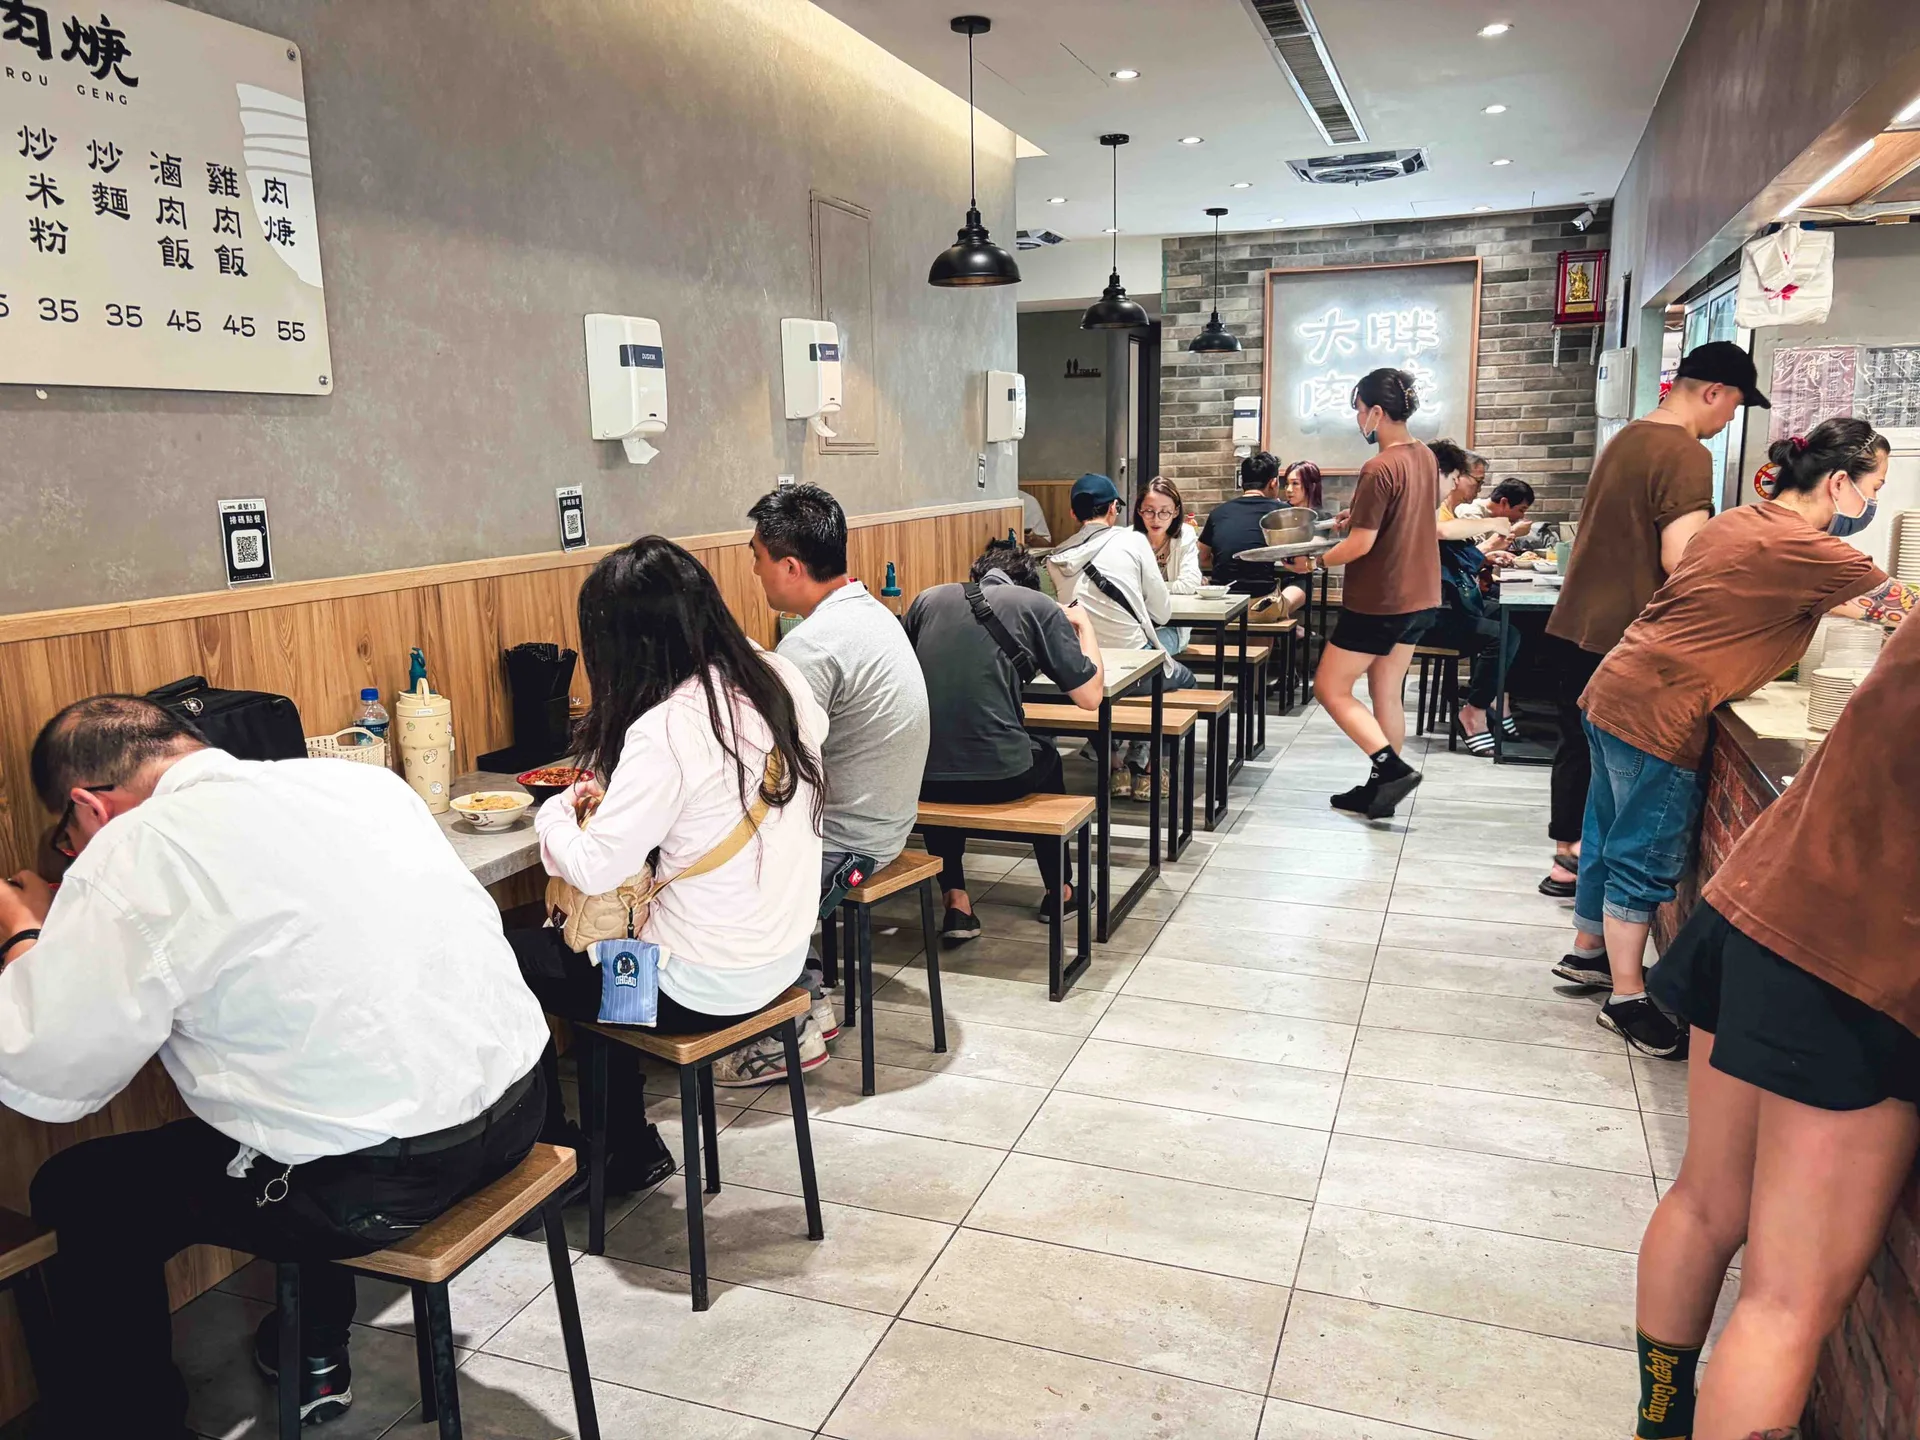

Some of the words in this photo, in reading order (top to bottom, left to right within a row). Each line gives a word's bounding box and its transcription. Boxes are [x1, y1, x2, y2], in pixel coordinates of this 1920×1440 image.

[5, 66, 49, 87] ROU
[76, 84, 128, 106] GENG
[17, 125, 69, 255] 炒米粉
[86, 139, 131, 221] 炒麵
[150, 151, 195, 271] 滷肉飯
[205, 162, 249, 278] 雞肉飯
[38, 297, 79, 323] 35
[105, 303, 143, 328] 35
[166, 309, 202, 333] 45
[222, 314, 256, 338] 45
[277, 320, 306, 342] 55
[1295, 306, 1442, 365] 大胖
[1644, 1348, 1680, 1385] Keep
[1641, 1382, 1678, 1424] Going
